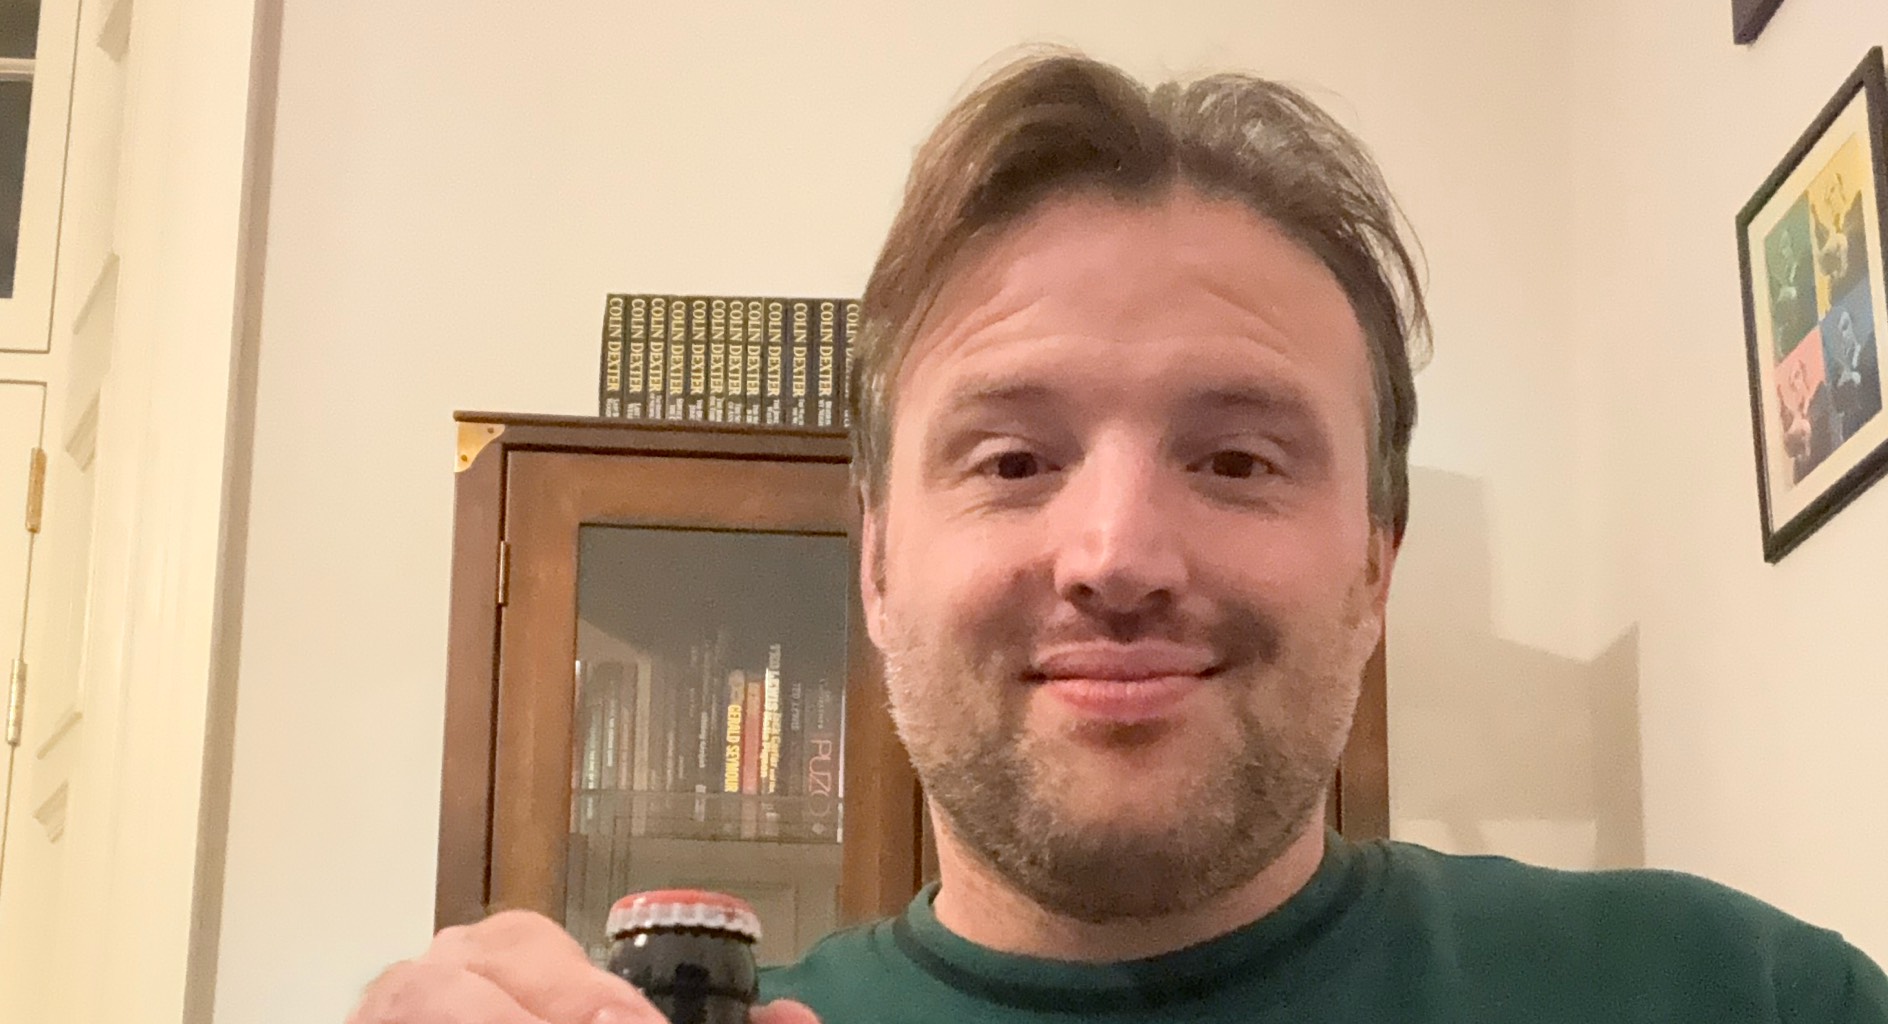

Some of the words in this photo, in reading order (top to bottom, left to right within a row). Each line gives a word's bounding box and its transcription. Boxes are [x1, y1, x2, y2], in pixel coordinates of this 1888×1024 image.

[608, 298, 623, 338] COLIN
[630, 299, 645, 339] COLIN
[650, 298, 665, 338] COLIN
[671, 301, 686, 341] COLIN
[692, 300, 706, 340] COLIN
[711, 300, 726, 340] COLIN
[729, 300, 743, 341] COLIN
[748, 301, 762, 341] COLIN
[768, 302, 783, 343] COLIN
[793, 303, 807, 343] COLIN
[820, 302, 834, 343] COLIN
[607, 341, 622, 391] DEXTER
[629, 342, 644, 393] DEXTER
[649, 341, 664, 394] DEXTER
[669, 343, 685, 395] DEXTER
[690, 343, 705, 394] DEXTER
[710, 343, 725, 394] DEXTER
[728, 343, 743, 395] DEXTER
[746, 345, 761, 395] DEXTER
[767, 346, 782, 396] DEXTER
[792, 346, 807, 397] DEXTER
[818, 346, 833, 396] DEXTER
[727, 704, 742, 742] GERALD
[725, 744, 740, 792] SEYMOUR
[808, 739, 832, 817] PUZO
